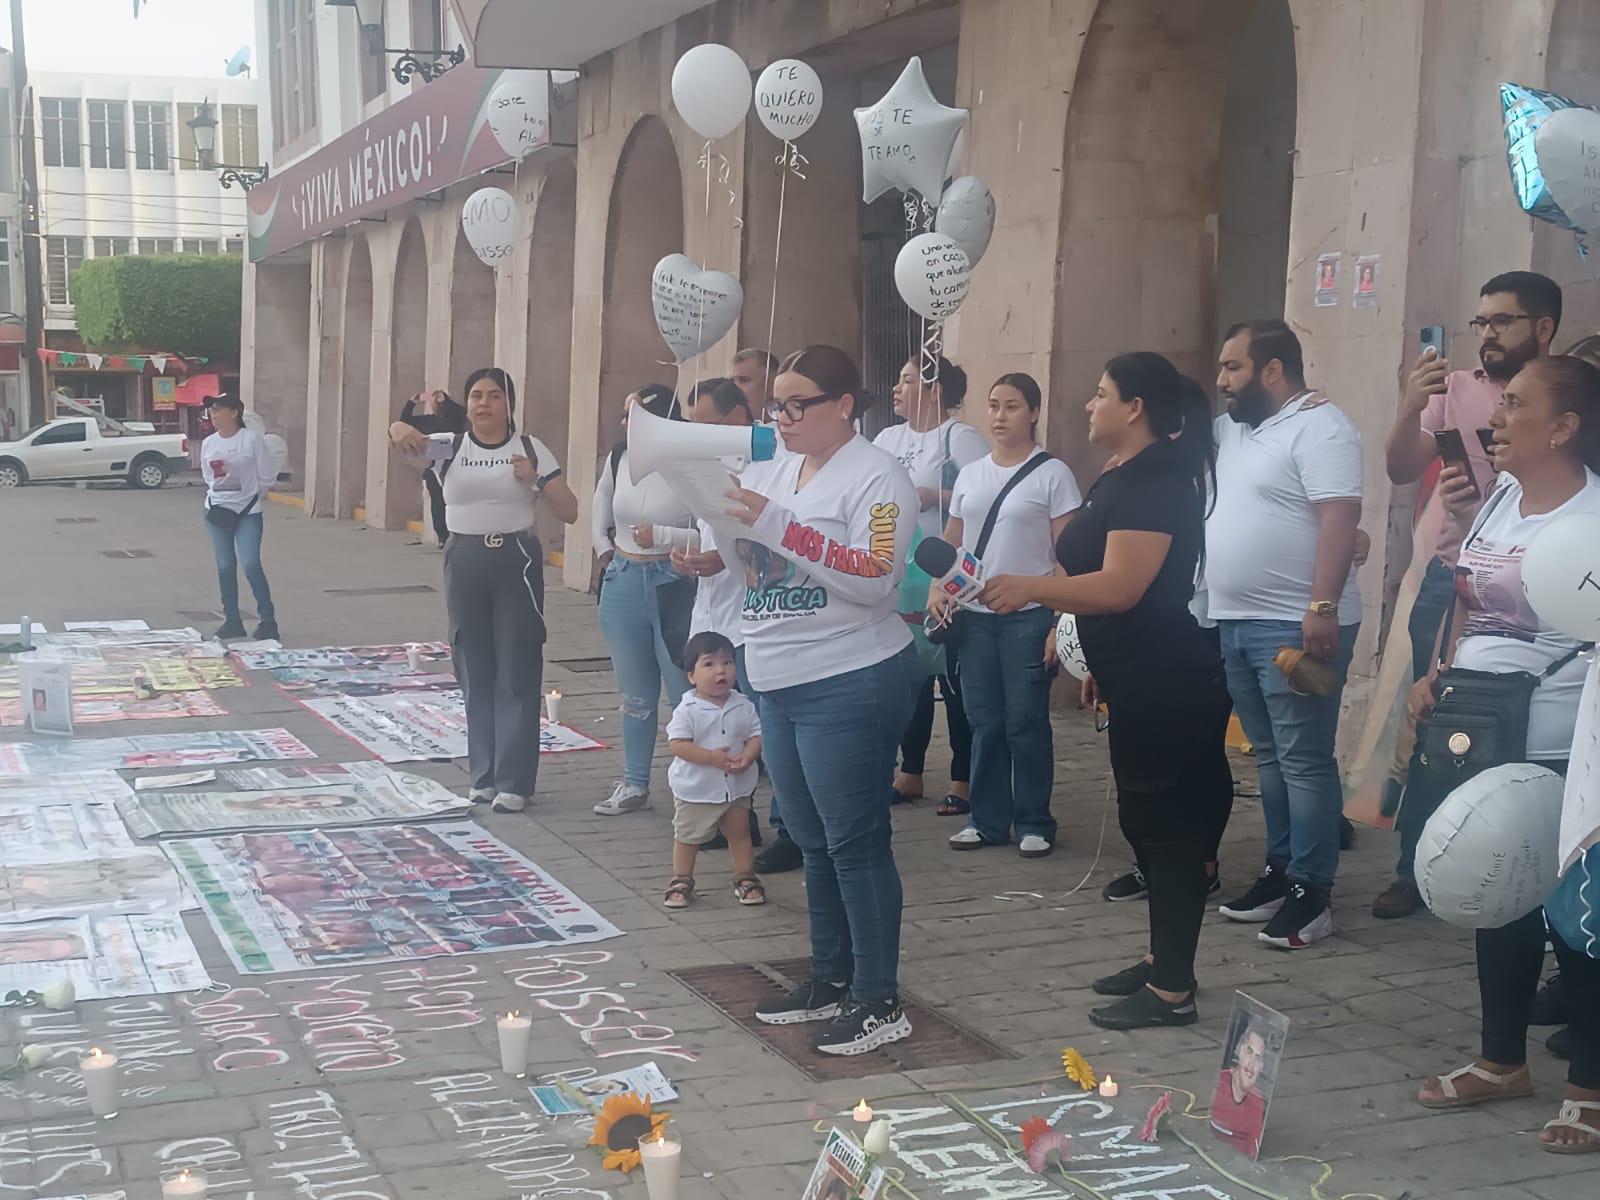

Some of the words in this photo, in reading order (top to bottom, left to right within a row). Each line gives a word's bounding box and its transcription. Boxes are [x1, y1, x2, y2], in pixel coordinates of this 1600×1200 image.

[776, 65, 798, 81] TE
[760, 89, 815, 110] QUIERO
[769, 110, 814, 126] MUCHO
[892, 108, 913, 125] TE
[867, 145, 882, 161] TE
[301, 165, 343, 231] ¡VIVA
[349, 115, 433, 209] MÉXICO!
[781, 519, 826, 563] NOS
[104, 1000, 196, 1060] JUAN
